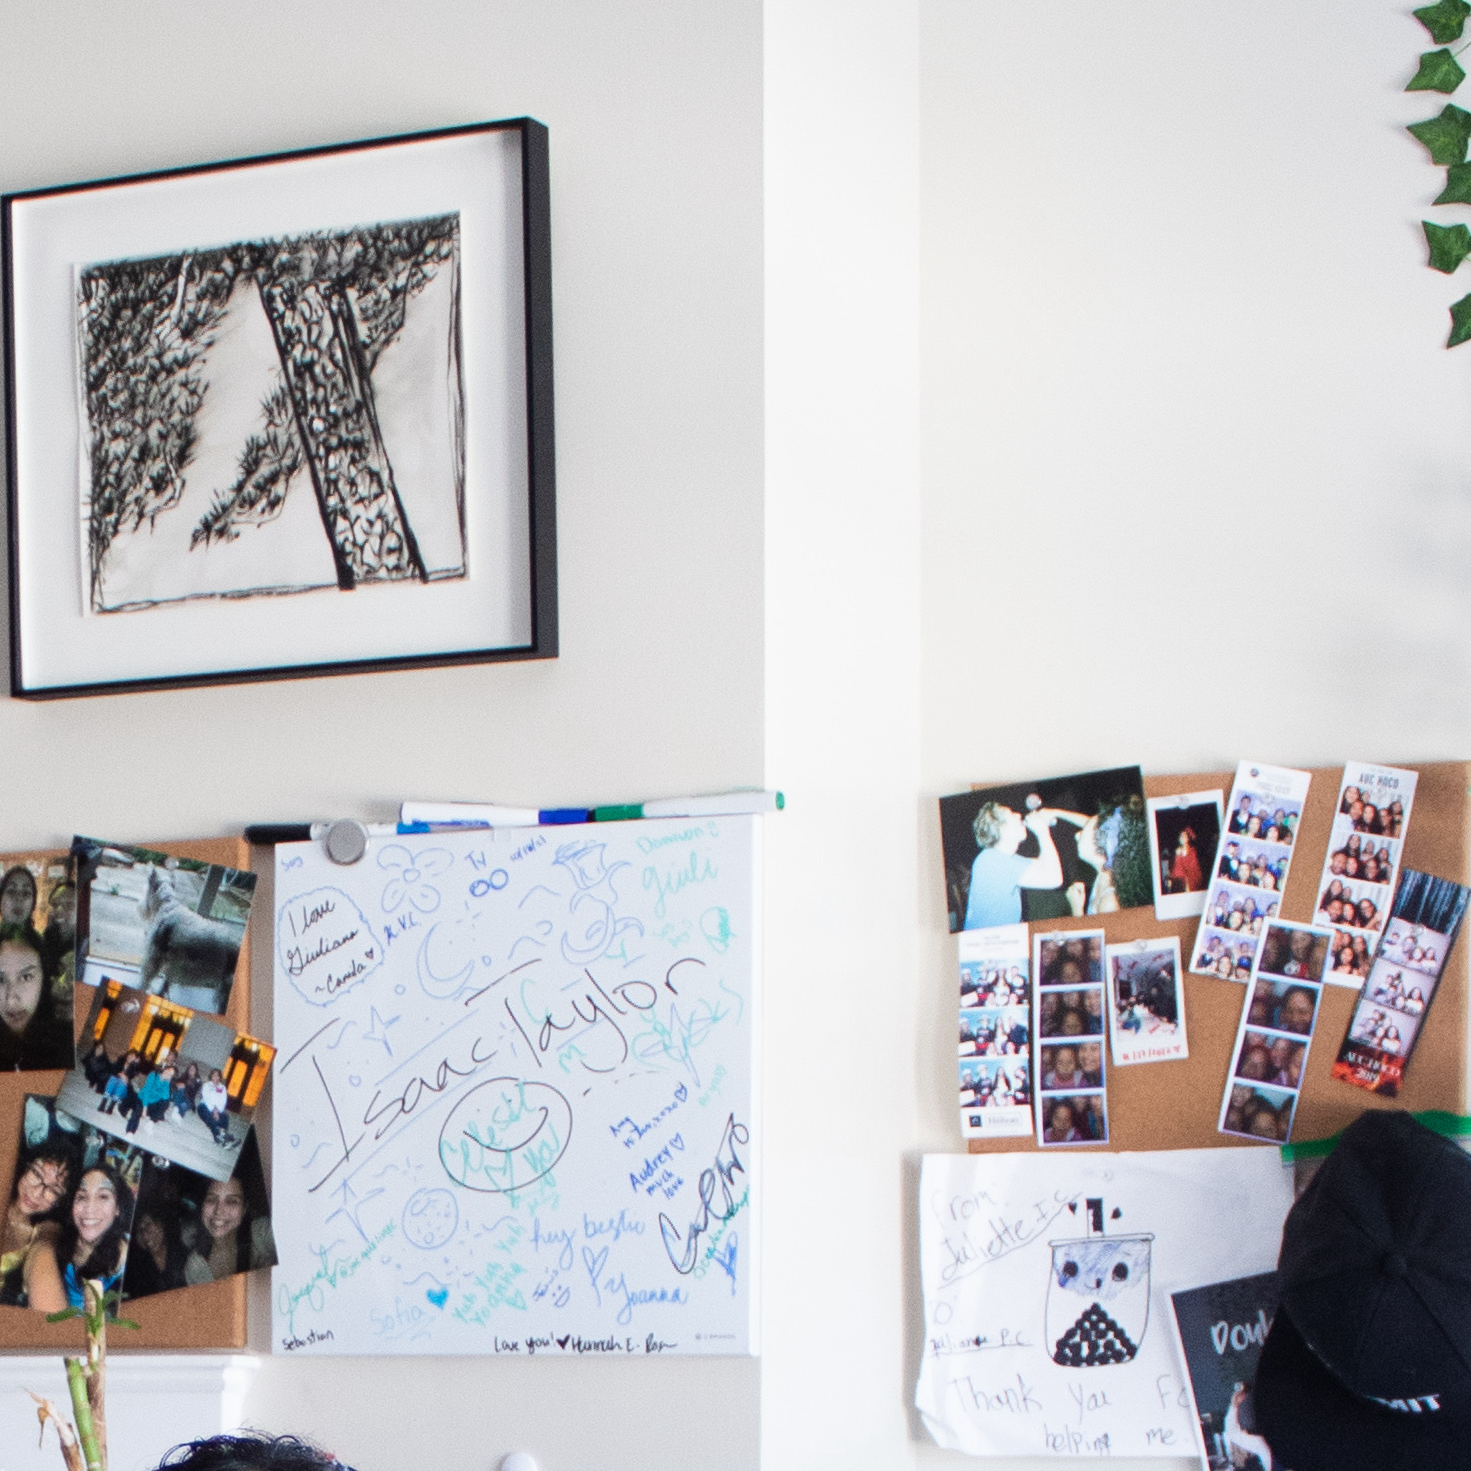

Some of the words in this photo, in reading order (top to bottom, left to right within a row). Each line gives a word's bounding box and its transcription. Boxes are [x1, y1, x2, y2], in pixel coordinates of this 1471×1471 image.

[288, 910, 297, 938] I
[302, 899, 336, 935] love
[280, 1018, 497, 1193] Isaac
[464, 957, 707, 1072] Taylor
[947, 1372, 1044, 1414] Thank
